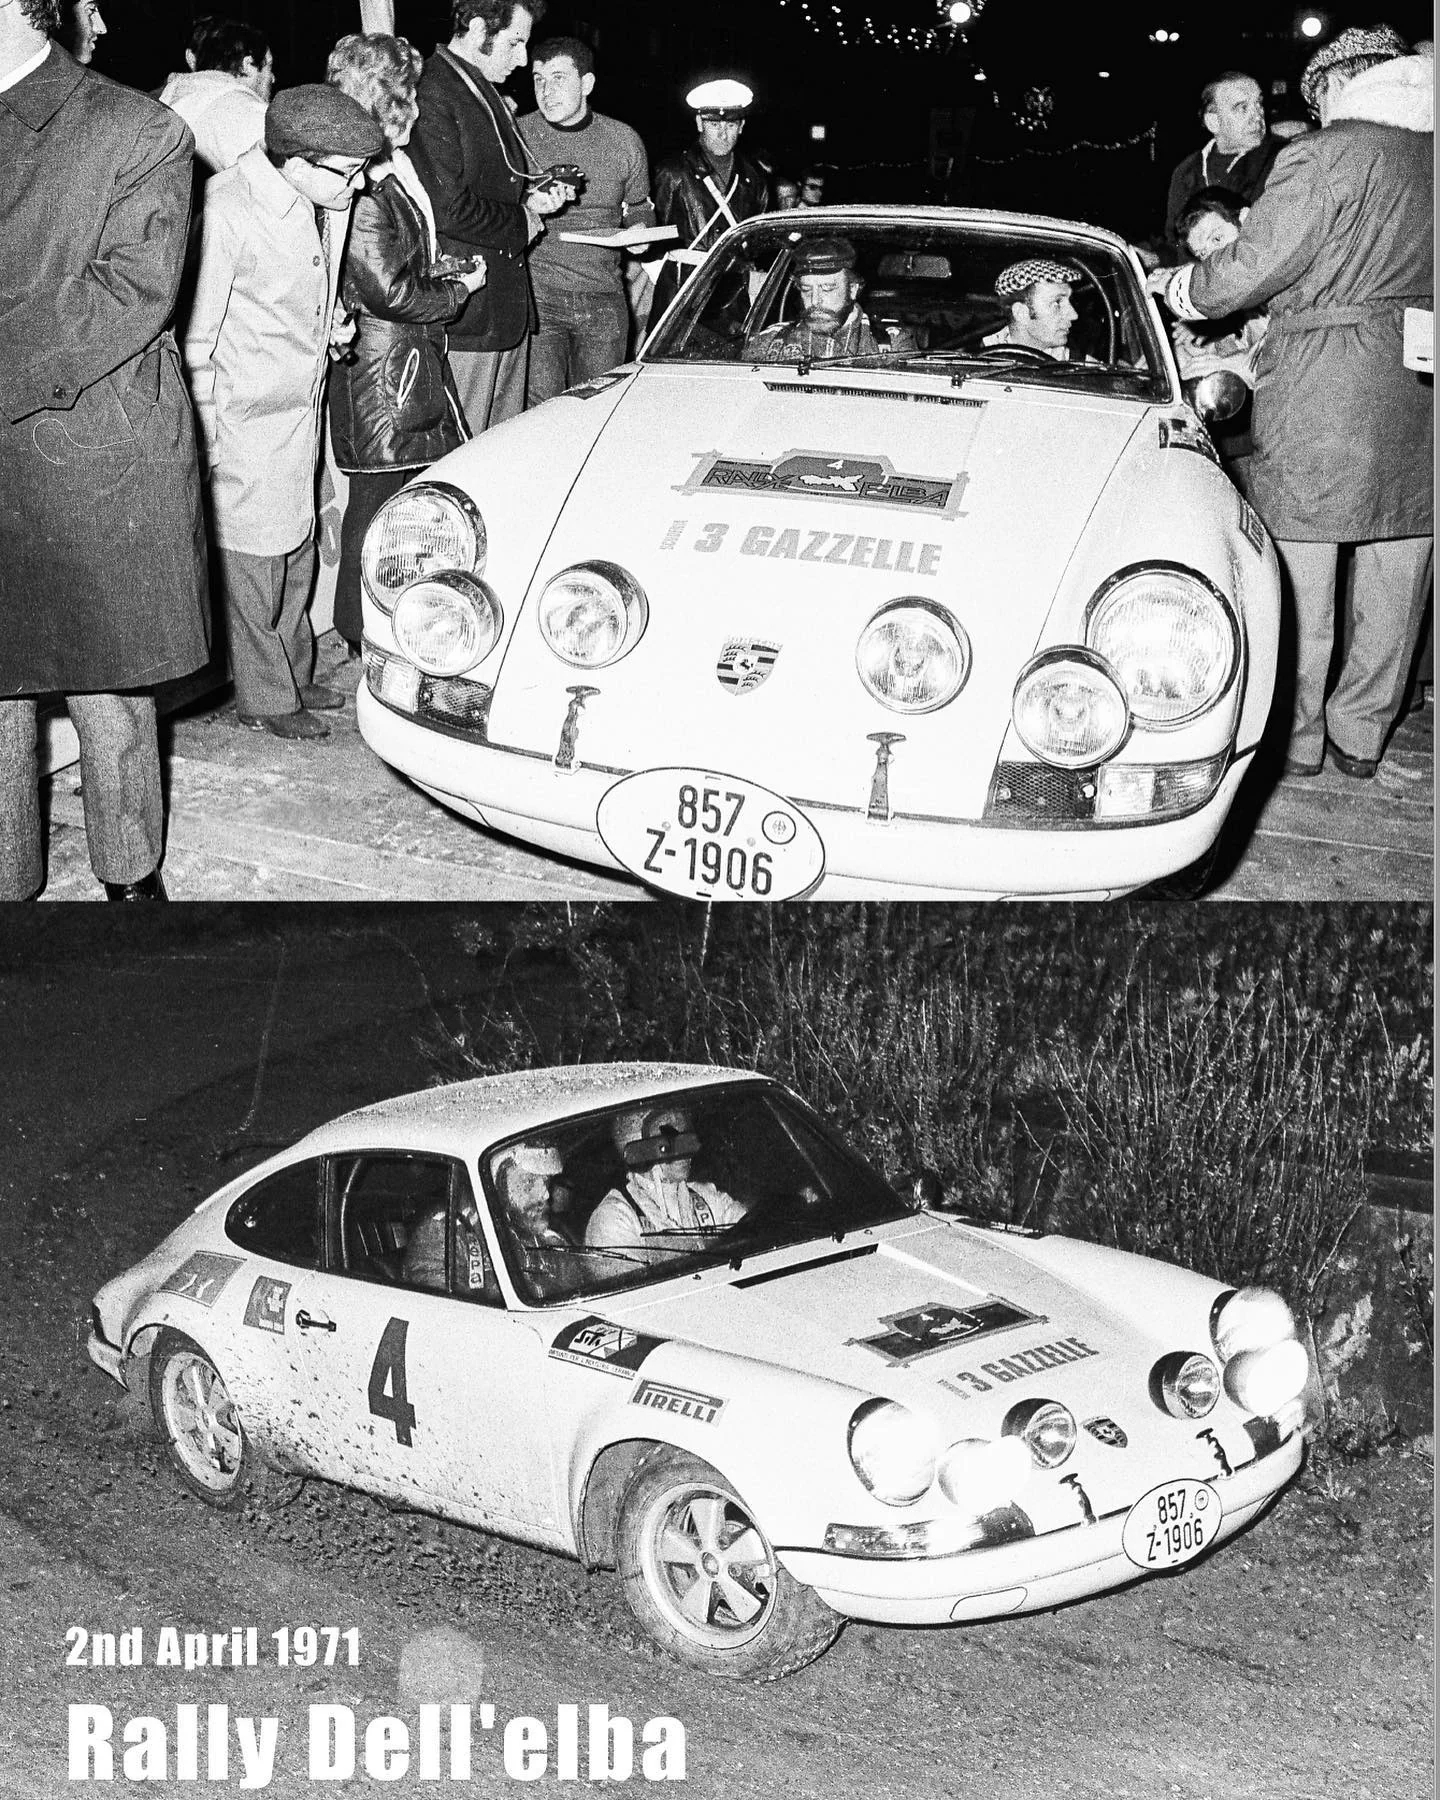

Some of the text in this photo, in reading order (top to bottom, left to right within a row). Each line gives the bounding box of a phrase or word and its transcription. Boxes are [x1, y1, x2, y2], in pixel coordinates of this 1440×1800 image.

[693, 522, 730, 553] 3
[740, 525, 943, 576] GAZZELLE
[677, 784, 746, 837] 857
[643, 827, 774, 896] Z-1906
[367, 1316, 417, 1448] 4
[956, 1371, 993, 1392] 3
[980, 1337, 1100, 1383] GAZZELLE
[632, 1379, 725, 1424] PIRELLI
[1157, 1489, 1186, 1524] 857
[1146, 1518, 1204, 1561] Z-1906
